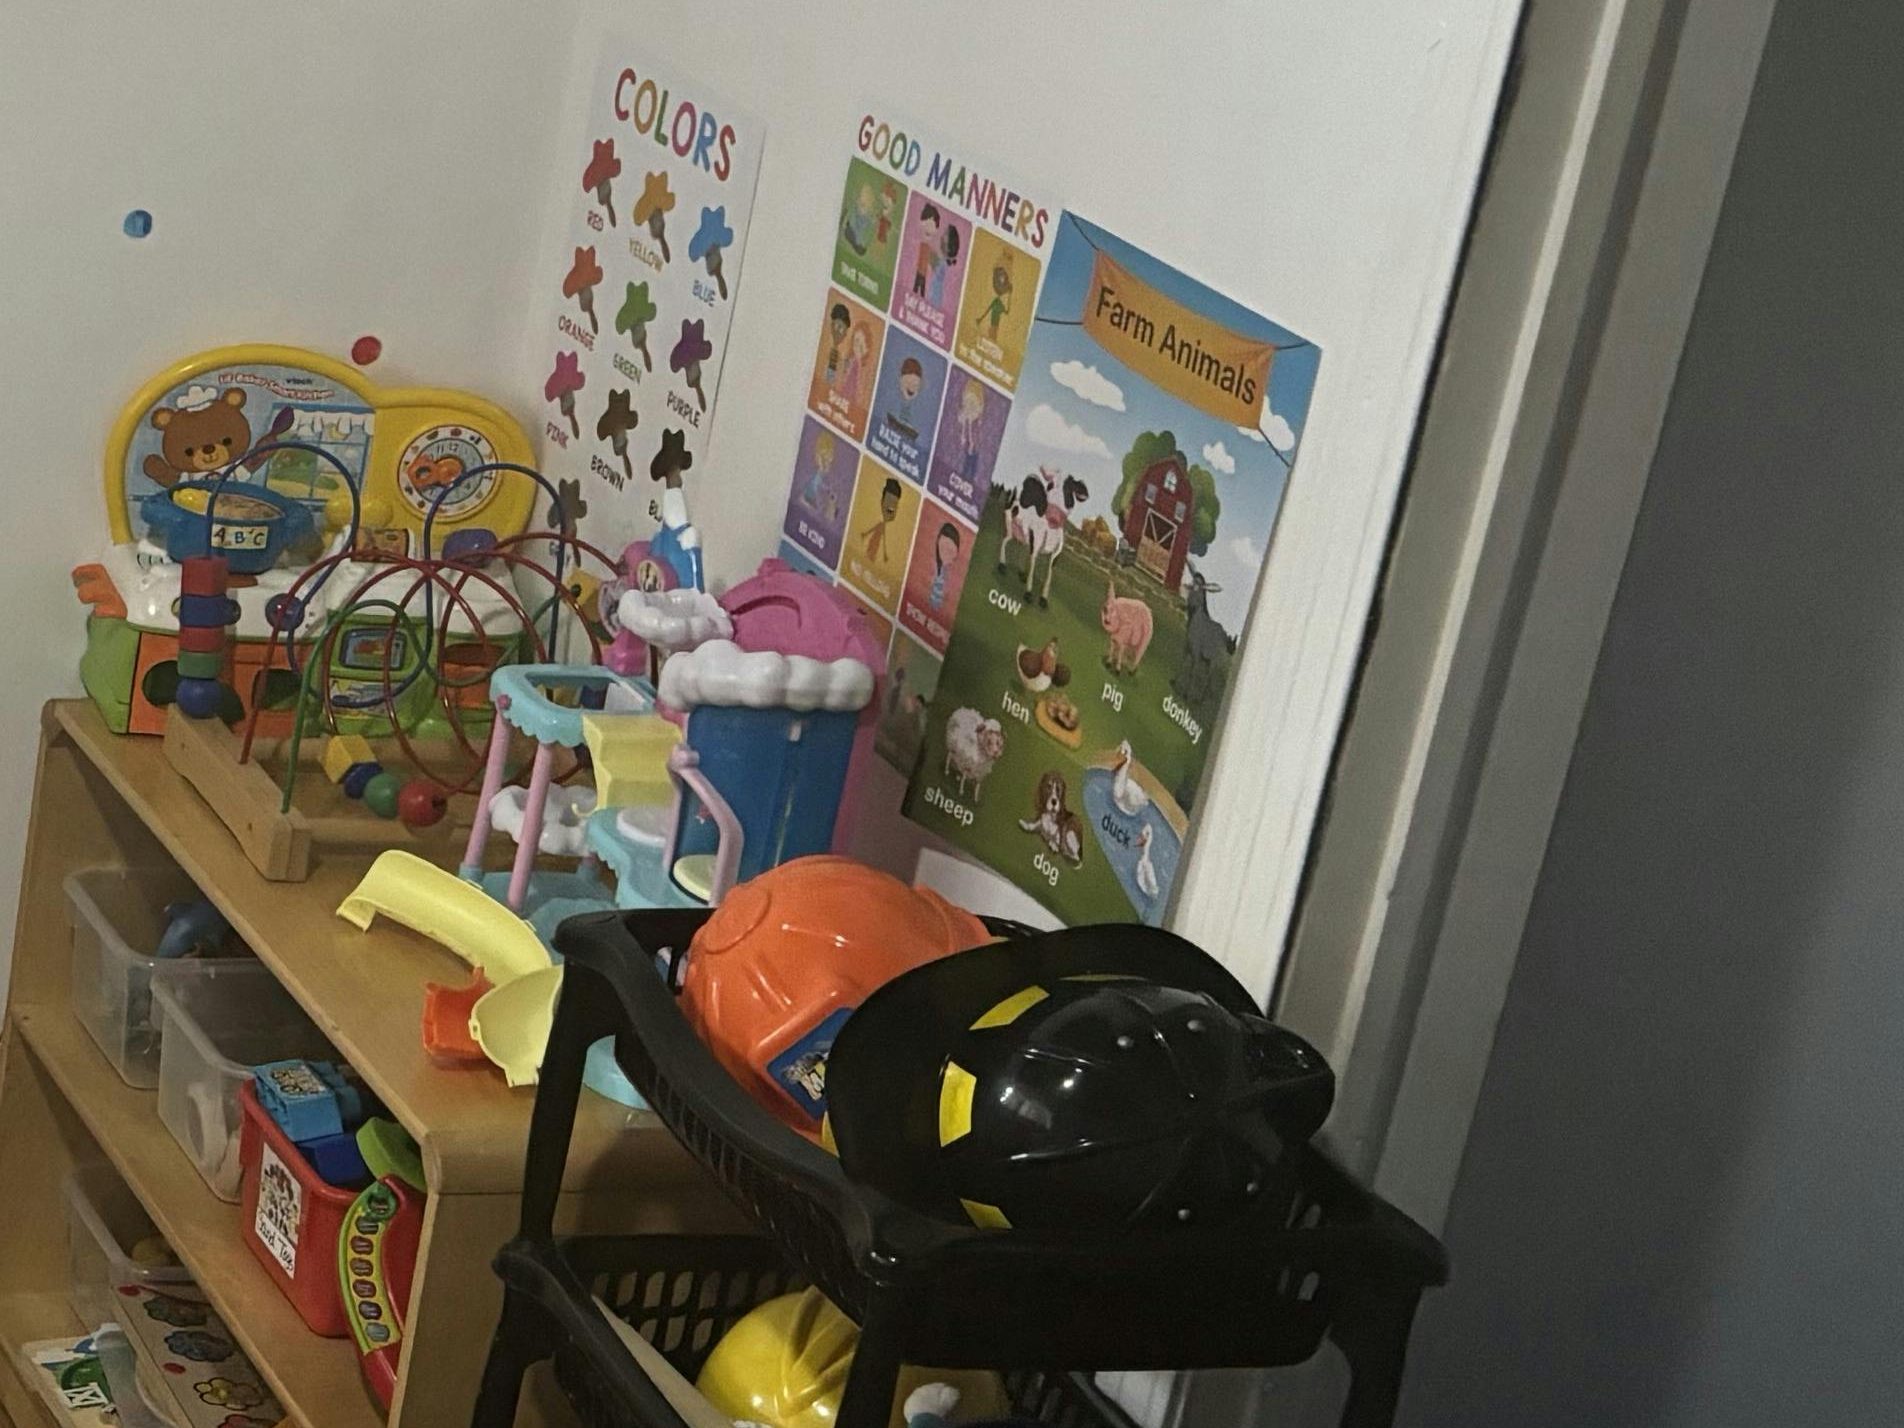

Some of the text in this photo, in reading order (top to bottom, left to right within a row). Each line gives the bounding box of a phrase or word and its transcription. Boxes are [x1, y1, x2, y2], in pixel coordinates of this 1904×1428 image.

[614, 68, 736, 182] COLORS
[858, 114, 1049, 249] GOOD MANNERS
[587, 210, 604, 232] RED
[628, 236, 663, 273] YELLOW
[692, 279, 716, 308] BLUE
[558, 315, 595, 352] ORANGE
[1096, 286, 1257, 406] Farm Animals
[613, 353, 642, 385] GREEN
[666, 390, 701, 429] PURPLE
[546, 421, 569, 449] PINK
[591, 454, 625, 492] BROWN
[988, 588, 1022, 617] cow
[1002, 691, 1030, 723] hen
[1101, 682, 1124, 712] pig
[1162, 695, 1203, 745] donkey
[924, 786, 974, 827] sheep
[1101, 812, 1131, 850] duck
[1033, 853, 1059, 887] dog
